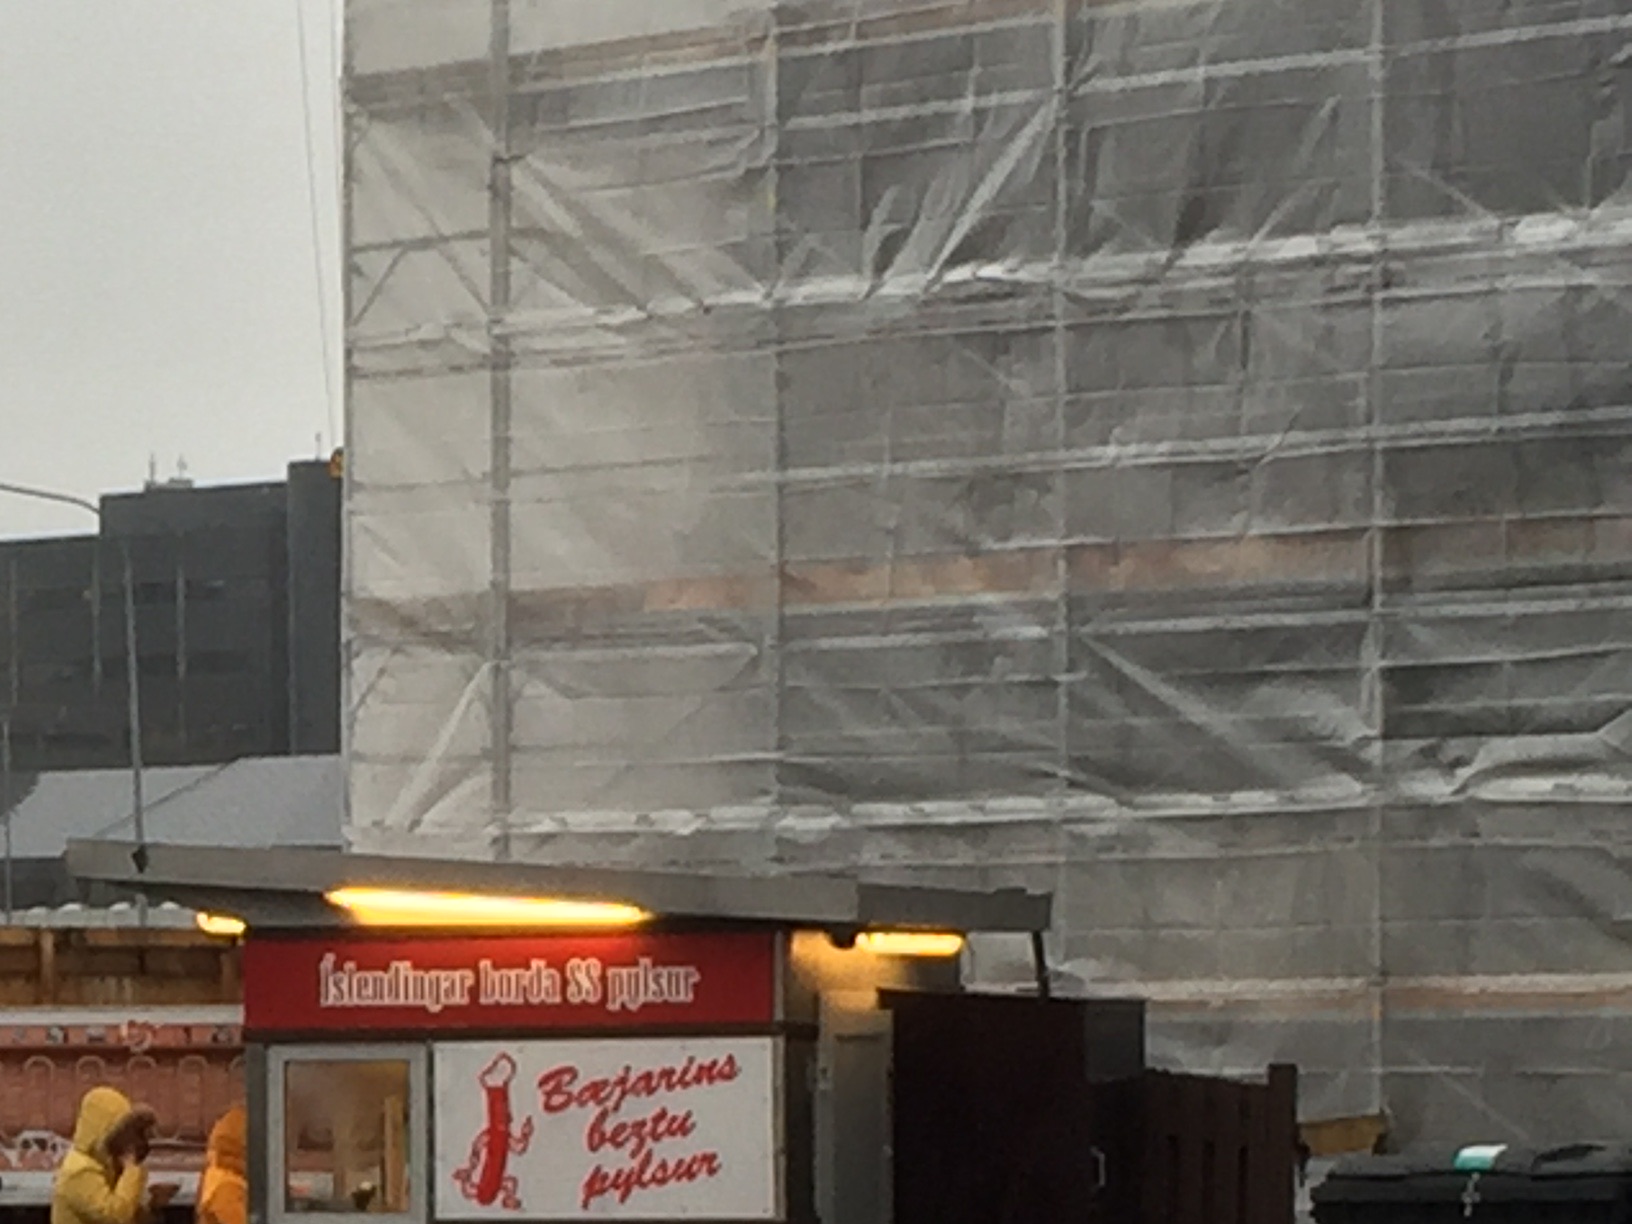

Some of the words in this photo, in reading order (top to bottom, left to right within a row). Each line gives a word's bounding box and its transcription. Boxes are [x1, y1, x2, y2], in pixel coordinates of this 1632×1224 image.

[566, 957, 602, 1004] SS
[605, 956, 701, 1013] pylsur
[587, 1107, 697, 1160] beztu
[581, 1149, 722, 1211] pylsur
